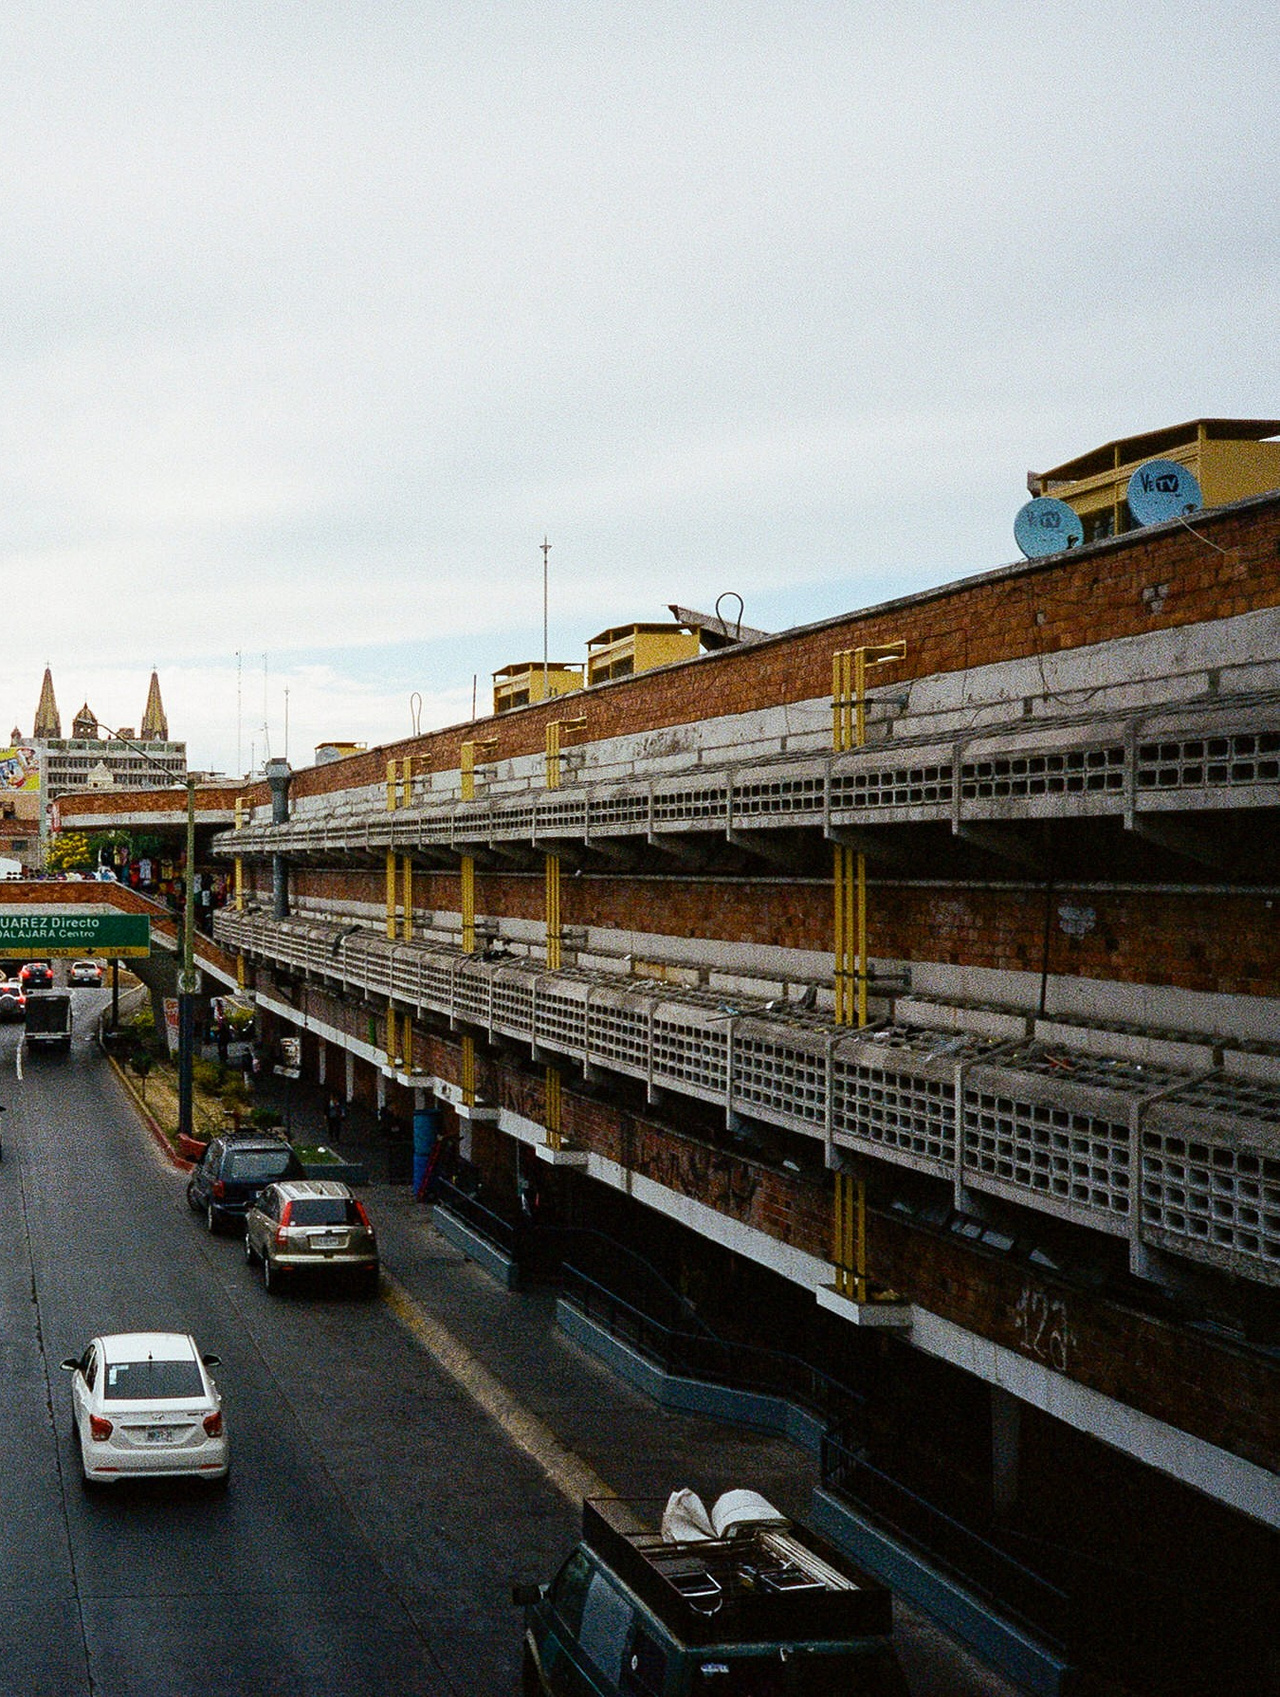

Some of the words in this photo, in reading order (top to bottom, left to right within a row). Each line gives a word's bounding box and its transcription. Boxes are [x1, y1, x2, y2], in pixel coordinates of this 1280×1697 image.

[51, 916, 100, 929] Directo
[59, 929, 96, 939] Centro
[46, 949, 69, 957] SOLO
